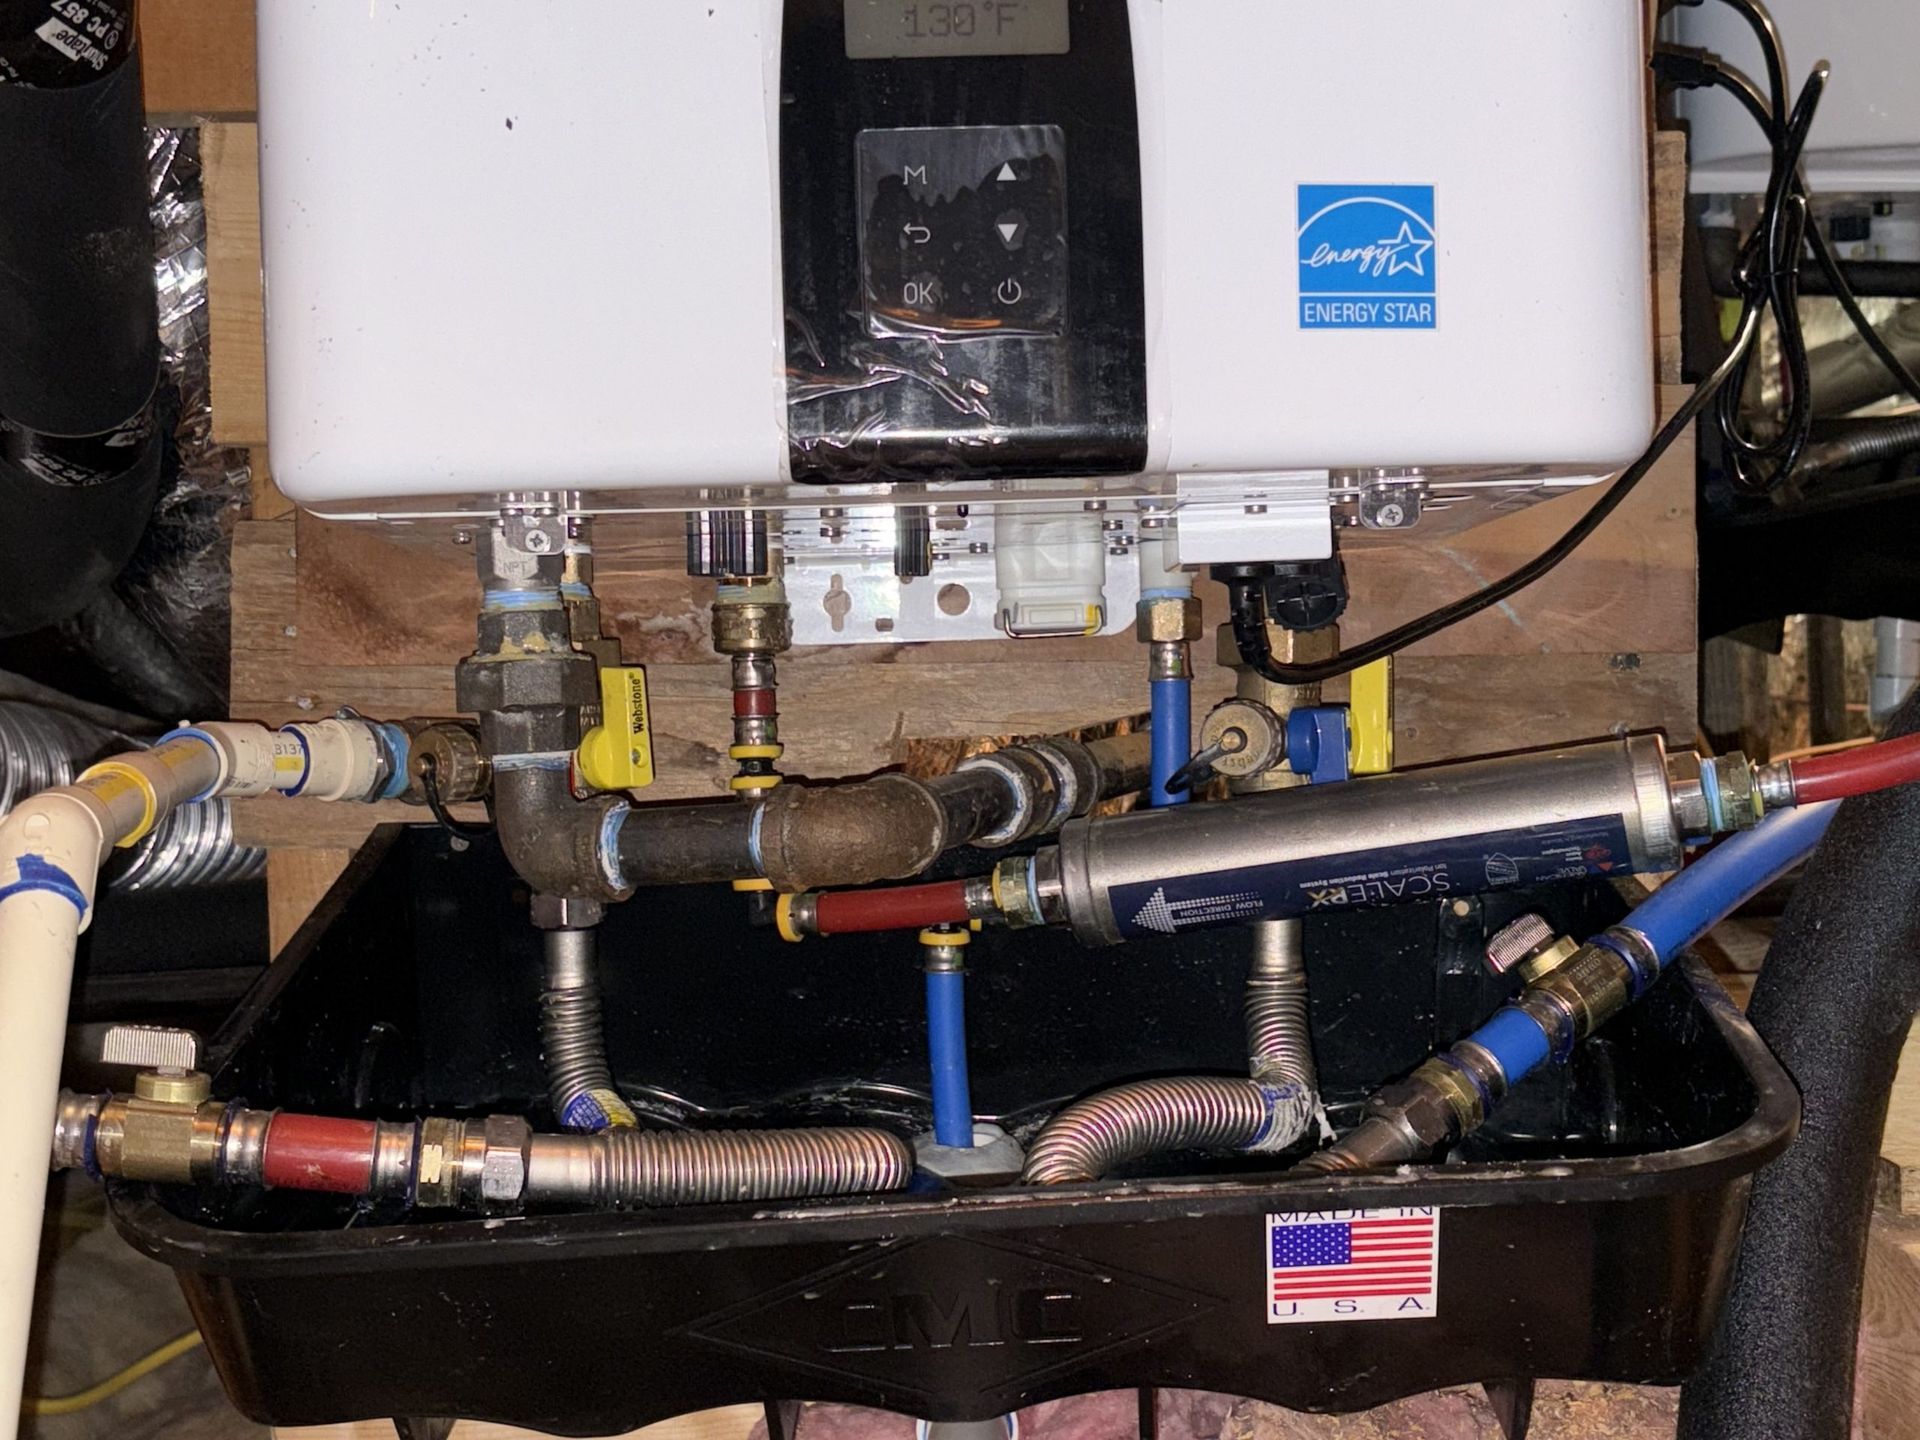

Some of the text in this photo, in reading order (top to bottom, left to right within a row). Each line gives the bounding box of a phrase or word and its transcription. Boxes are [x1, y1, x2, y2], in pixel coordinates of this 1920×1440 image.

[50, 0, 89, 24] 857
[86, 16, 110, 39] PC
[55, 29, 109, 71] Shurtape
[903, 165, 928, 185] M
[1301, 242, 1392, 278] energy
[903, 282, 934, 305] OK
[1304, 303, 1432, 323] ENERGY STAR
[503, 561, 528, 575] NPT
[632, 677, 645, 735] Webstone
[1368, 870, 1389, 879] Scale
[1307, 872, 1450, 908] SCALERX
[1179, 899, 1264, 917] FLOW DIRECTION
[1272, 1206, 1433, 1223] MADE IN
